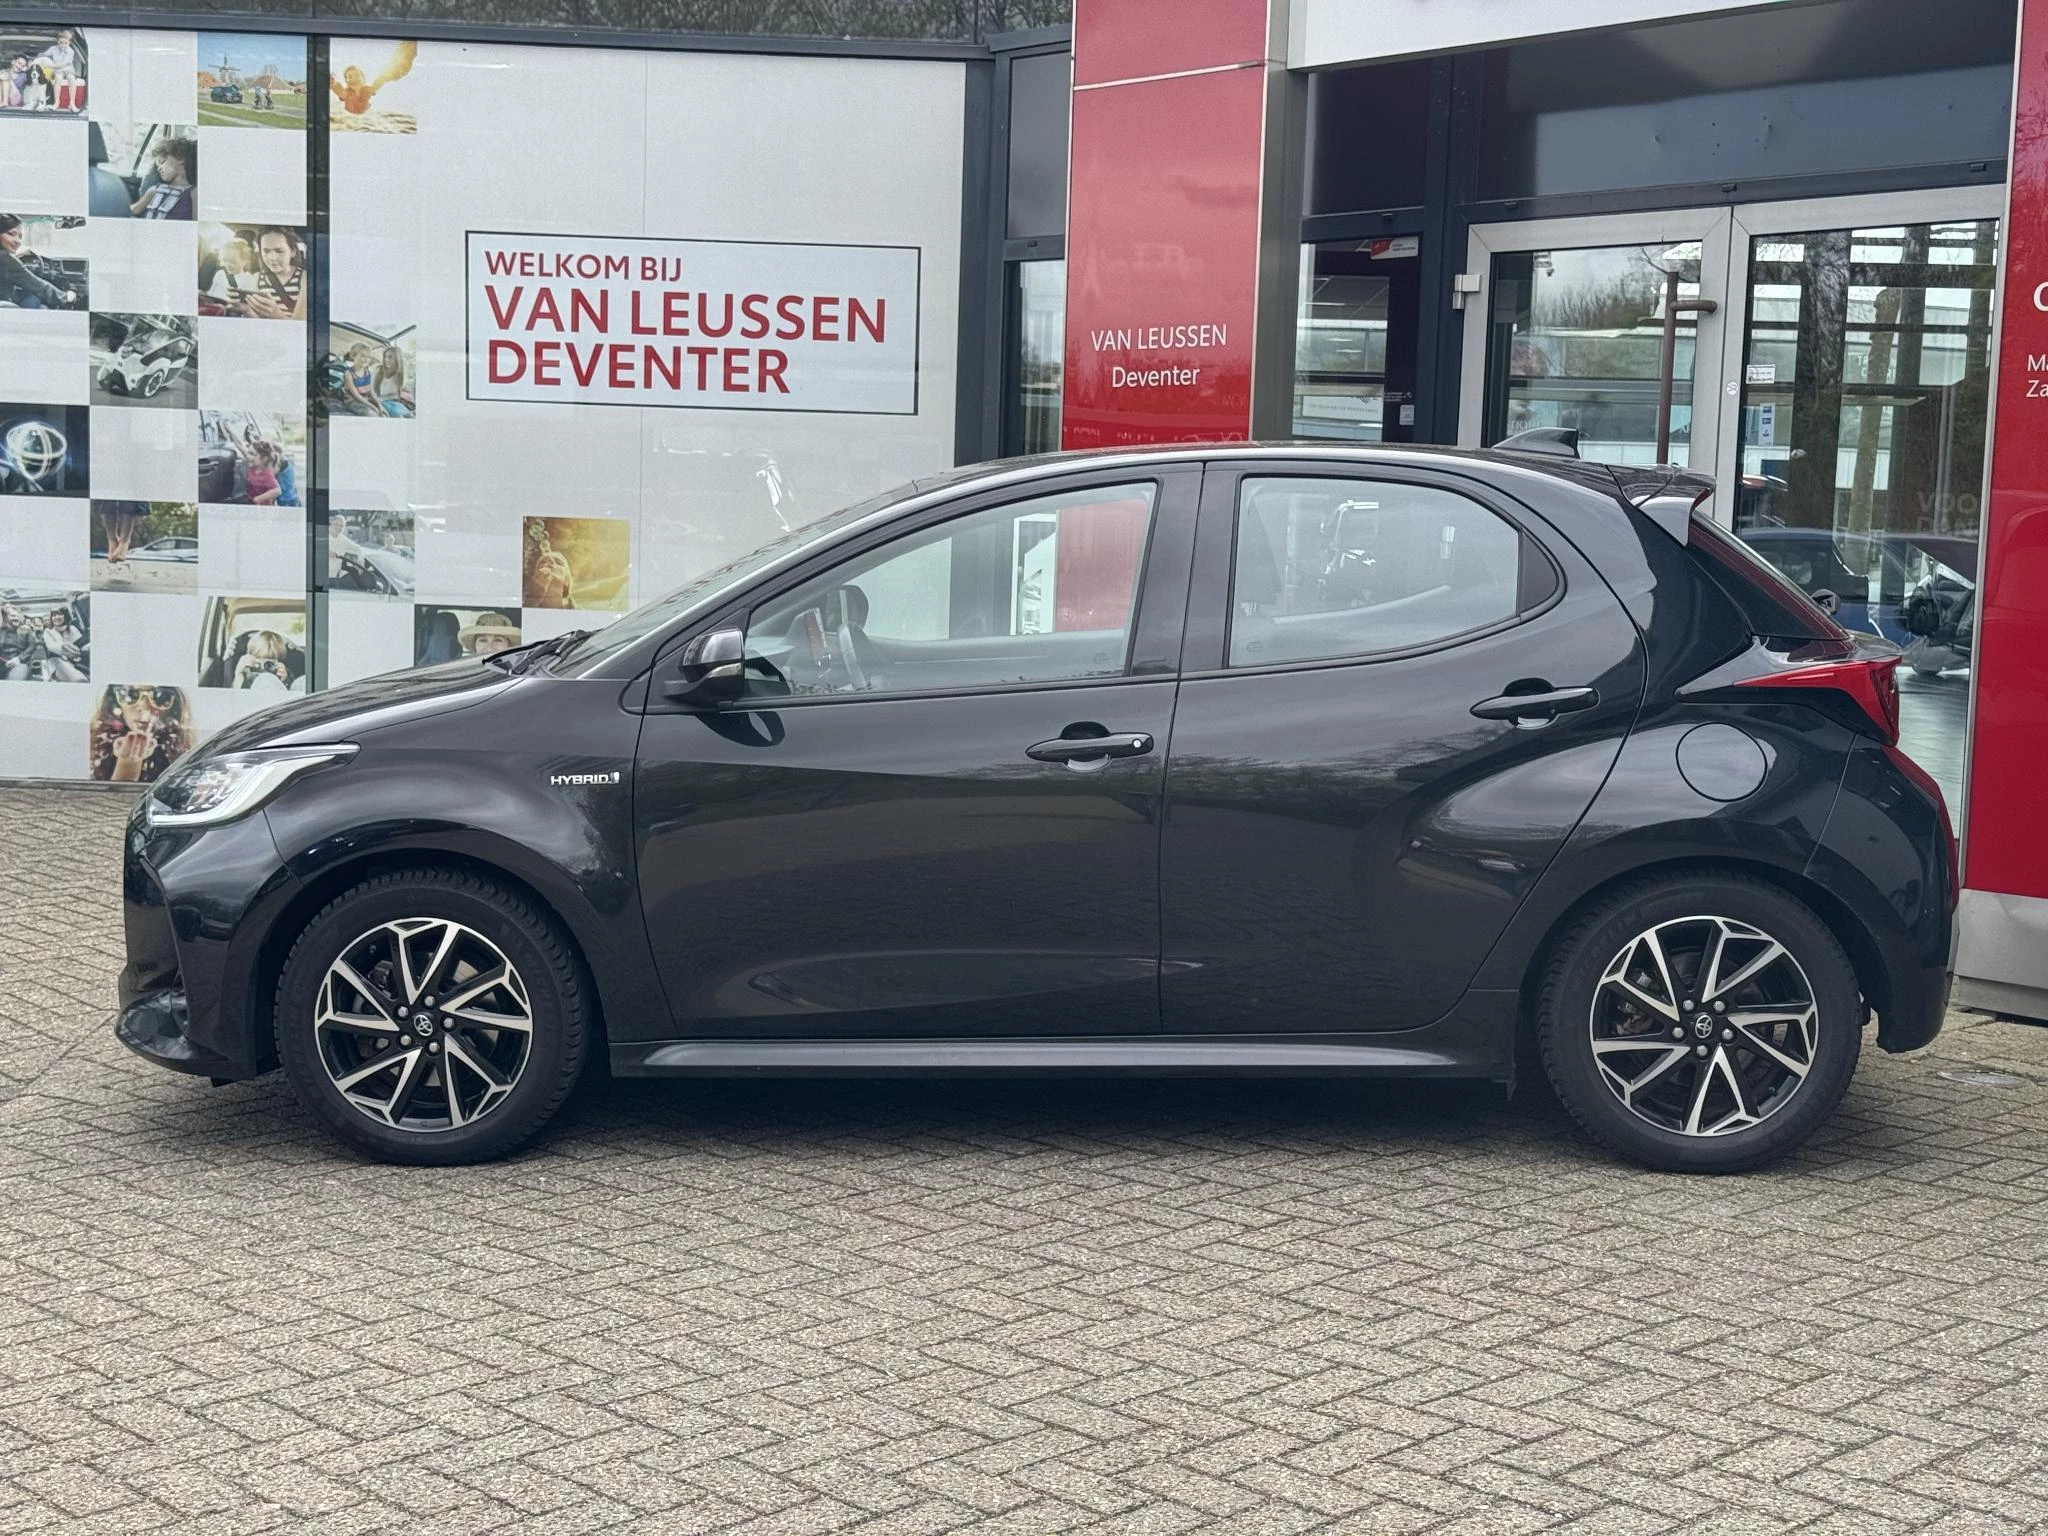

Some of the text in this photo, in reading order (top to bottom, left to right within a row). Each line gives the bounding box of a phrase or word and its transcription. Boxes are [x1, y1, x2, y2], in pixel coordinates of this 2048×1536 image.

[484, 250, 683, 283] WELKOM BIJ
[484, 285, 886, 343] VAN LEUSSEN
[1091, 323, 1227, 351] VAN LEUSSEN
[487, 339, 791, 394] DEVENTER
[1112, 366, 1201, 388] Deventer
[550, 774, 609, 786] HYBRID
